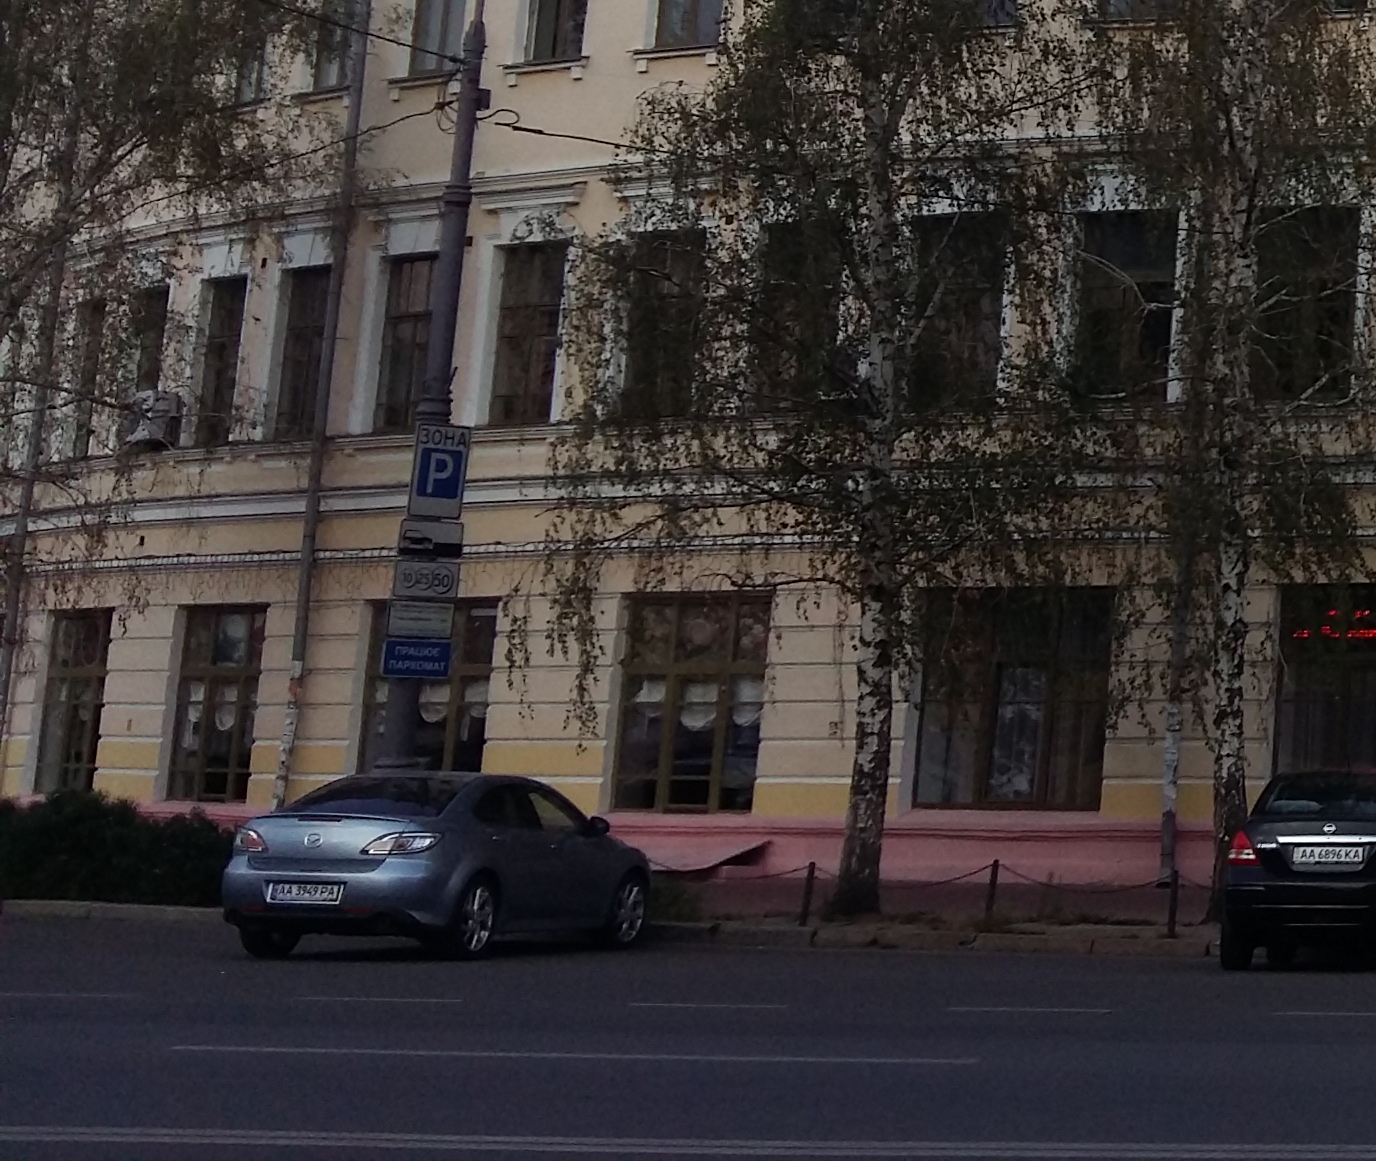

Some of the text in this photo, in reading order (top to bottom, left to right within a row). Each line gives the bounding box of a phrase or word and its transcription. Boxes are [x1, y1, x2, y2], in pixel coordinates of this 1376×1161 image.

[420, 427, 467, 448] ЗОНА
[433, 573, 450, 588] 50
[395, 645, 441, 657] ПРАЦЮЄ
[389, 659, 447, 672] ПАРКОМАТ
[1300, 848, 1361, 860] AA 6896 KA
[277, 885, 292, 896] AA
[320, 886, 335, 897] PA
